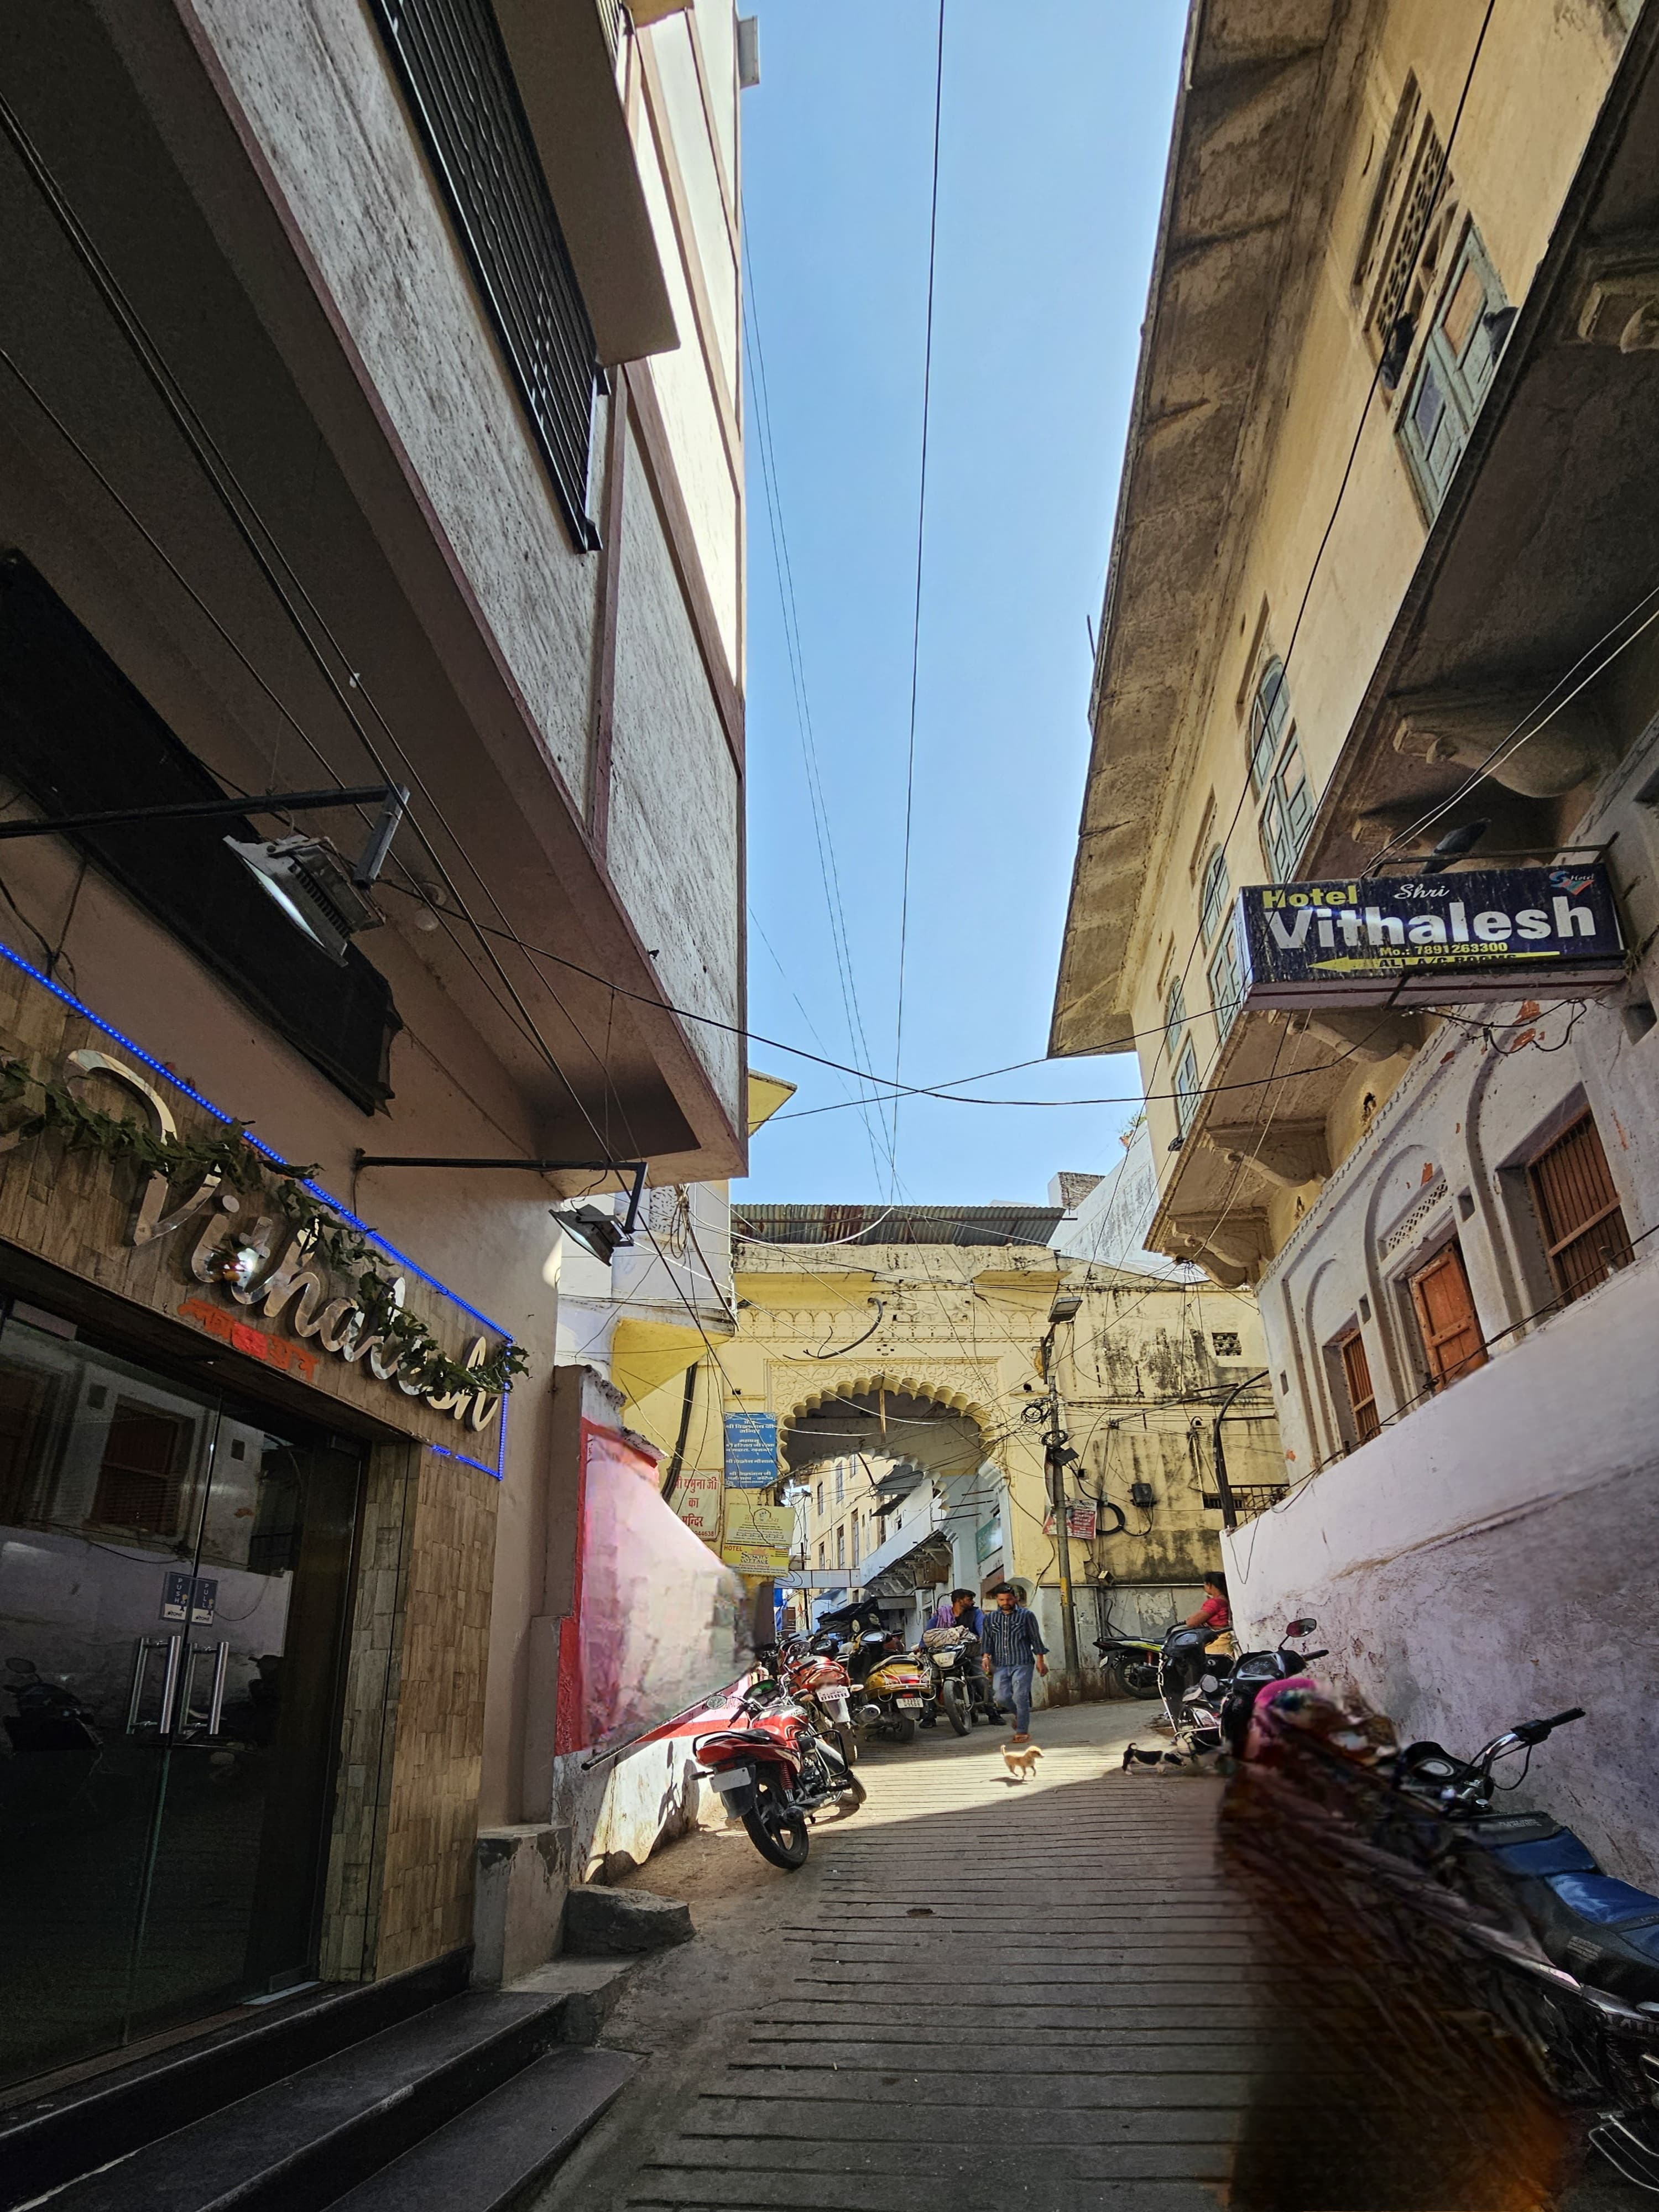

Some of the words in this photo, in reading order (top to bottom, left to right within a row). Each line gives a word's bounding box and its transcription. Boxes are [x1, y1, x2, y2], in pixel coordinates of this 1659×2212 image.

[1262, 885, 1358, 909] Hotel
[1394, 884, 1450, 899] Shri
[1264, 896, 1597, 949] Vithalesh
[1414, 942, 1509, 955] 7891263300
[684, 1479, 706, 1493] यमुना
[707, 1477, 718, 1490] जी
[688, 1498, 699, 1508] का
[682, 1513, 703, 1526] मन्दिर
[174, 1578, 183, 1603] PUSH
